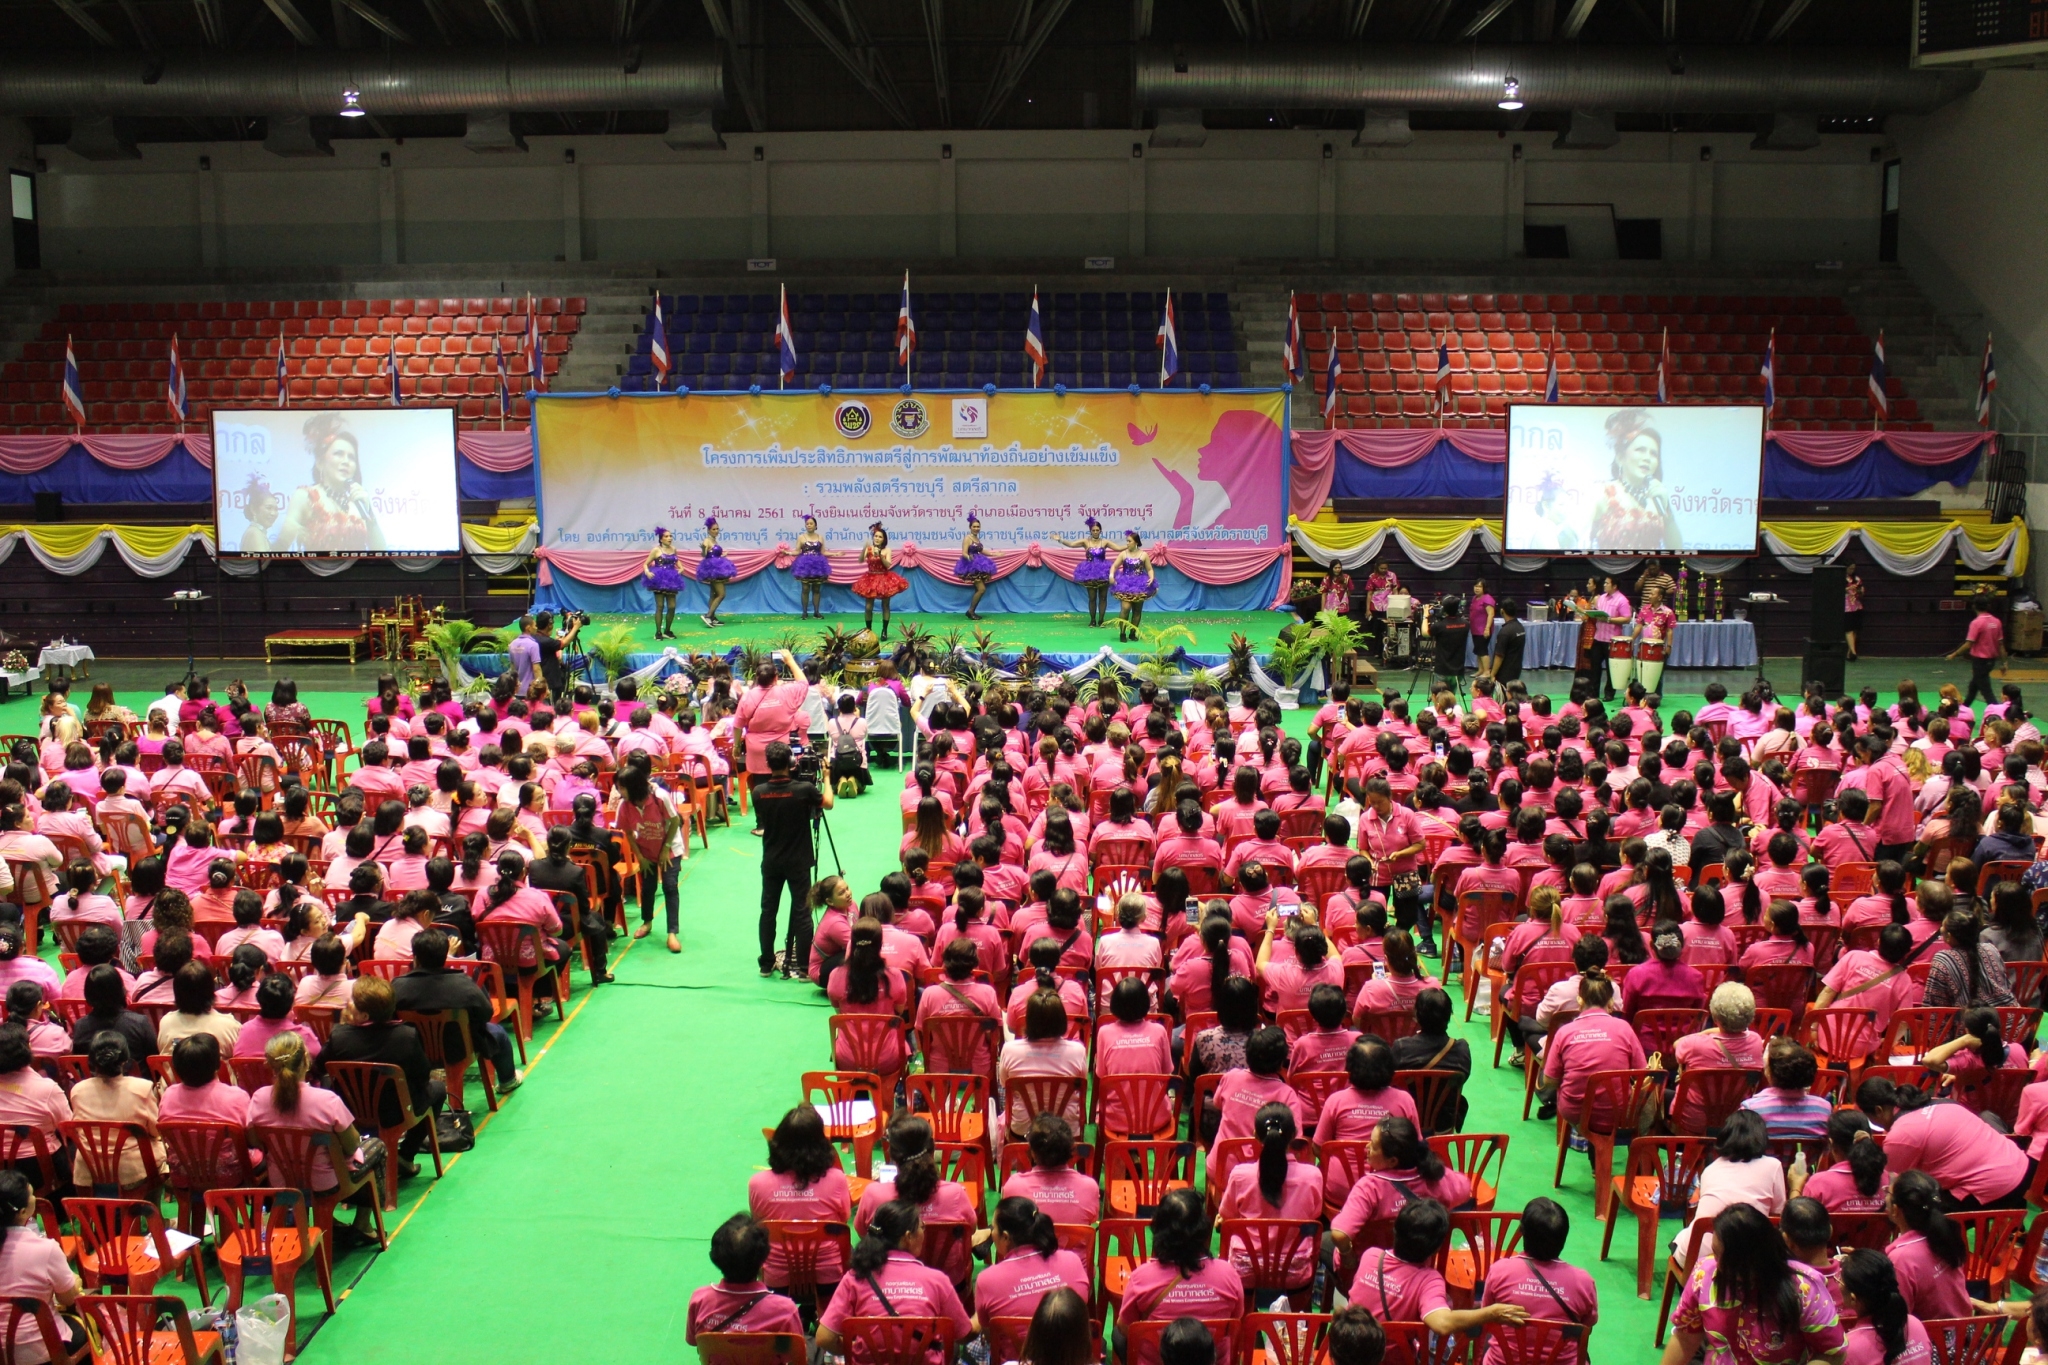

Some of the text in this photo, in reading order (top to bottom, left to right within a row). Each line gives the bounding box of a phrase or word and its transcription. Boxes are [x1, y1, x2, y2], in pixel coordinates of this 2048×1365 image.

[703, 443, 1117, 469] โครงการเพิ่มประสิทธิภาพสตรีสู่การพัฒนาท้องถิ่นอย่างเข้มแข็ง
[816, 477, 944, 497] รวมพลังสตรีราชบุรี
[952, 477, 1017, 493] สตรีสากล
[668, 503, 692, 519] วันที่
[698, 508, 705, 519] 8
[711, 505, 751, 519] มีนาคม
[757, 507, 785, 519] 2561
[1078, 503, 1153, 521] จังหวัดราชบุรี
[558, 527, 580, 543] โดย
[1013, 1274, 1061, 1293] บทบาทสตรี
[1168, 1287, 1215, 1298] บทบาทสตรี
